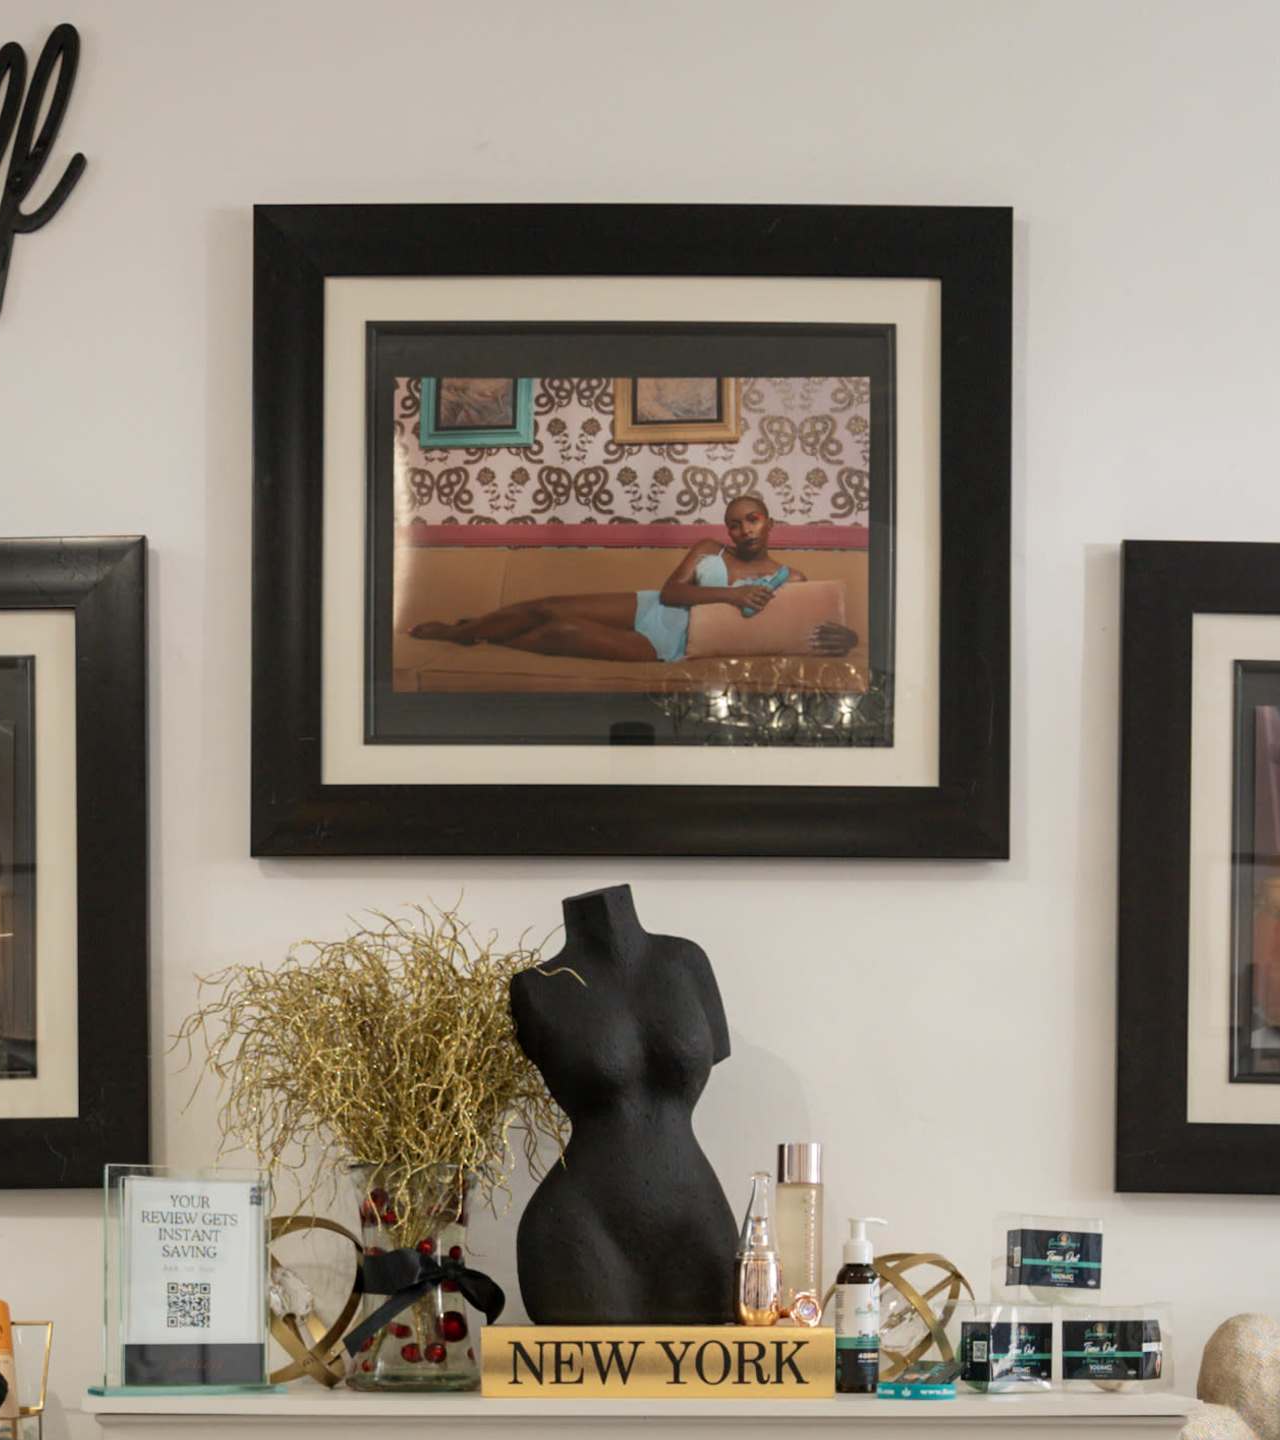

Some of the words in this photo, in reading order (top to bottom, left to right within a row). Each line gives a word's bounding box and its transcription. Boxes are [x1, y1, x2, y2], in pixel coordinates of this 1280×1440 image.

[170, 1194, 210, 1209] YOUR
[141, 1210, 198, 1225] REVIEW
[201, 1213, 238, 1226] GETS
[158, 1227, 221, 1242] INSTANT
[161, 1244, 217, 1259] SAVING
[508, 1341, 645, 1385] NEW
[656, 1340, 810, 1386] YORK
